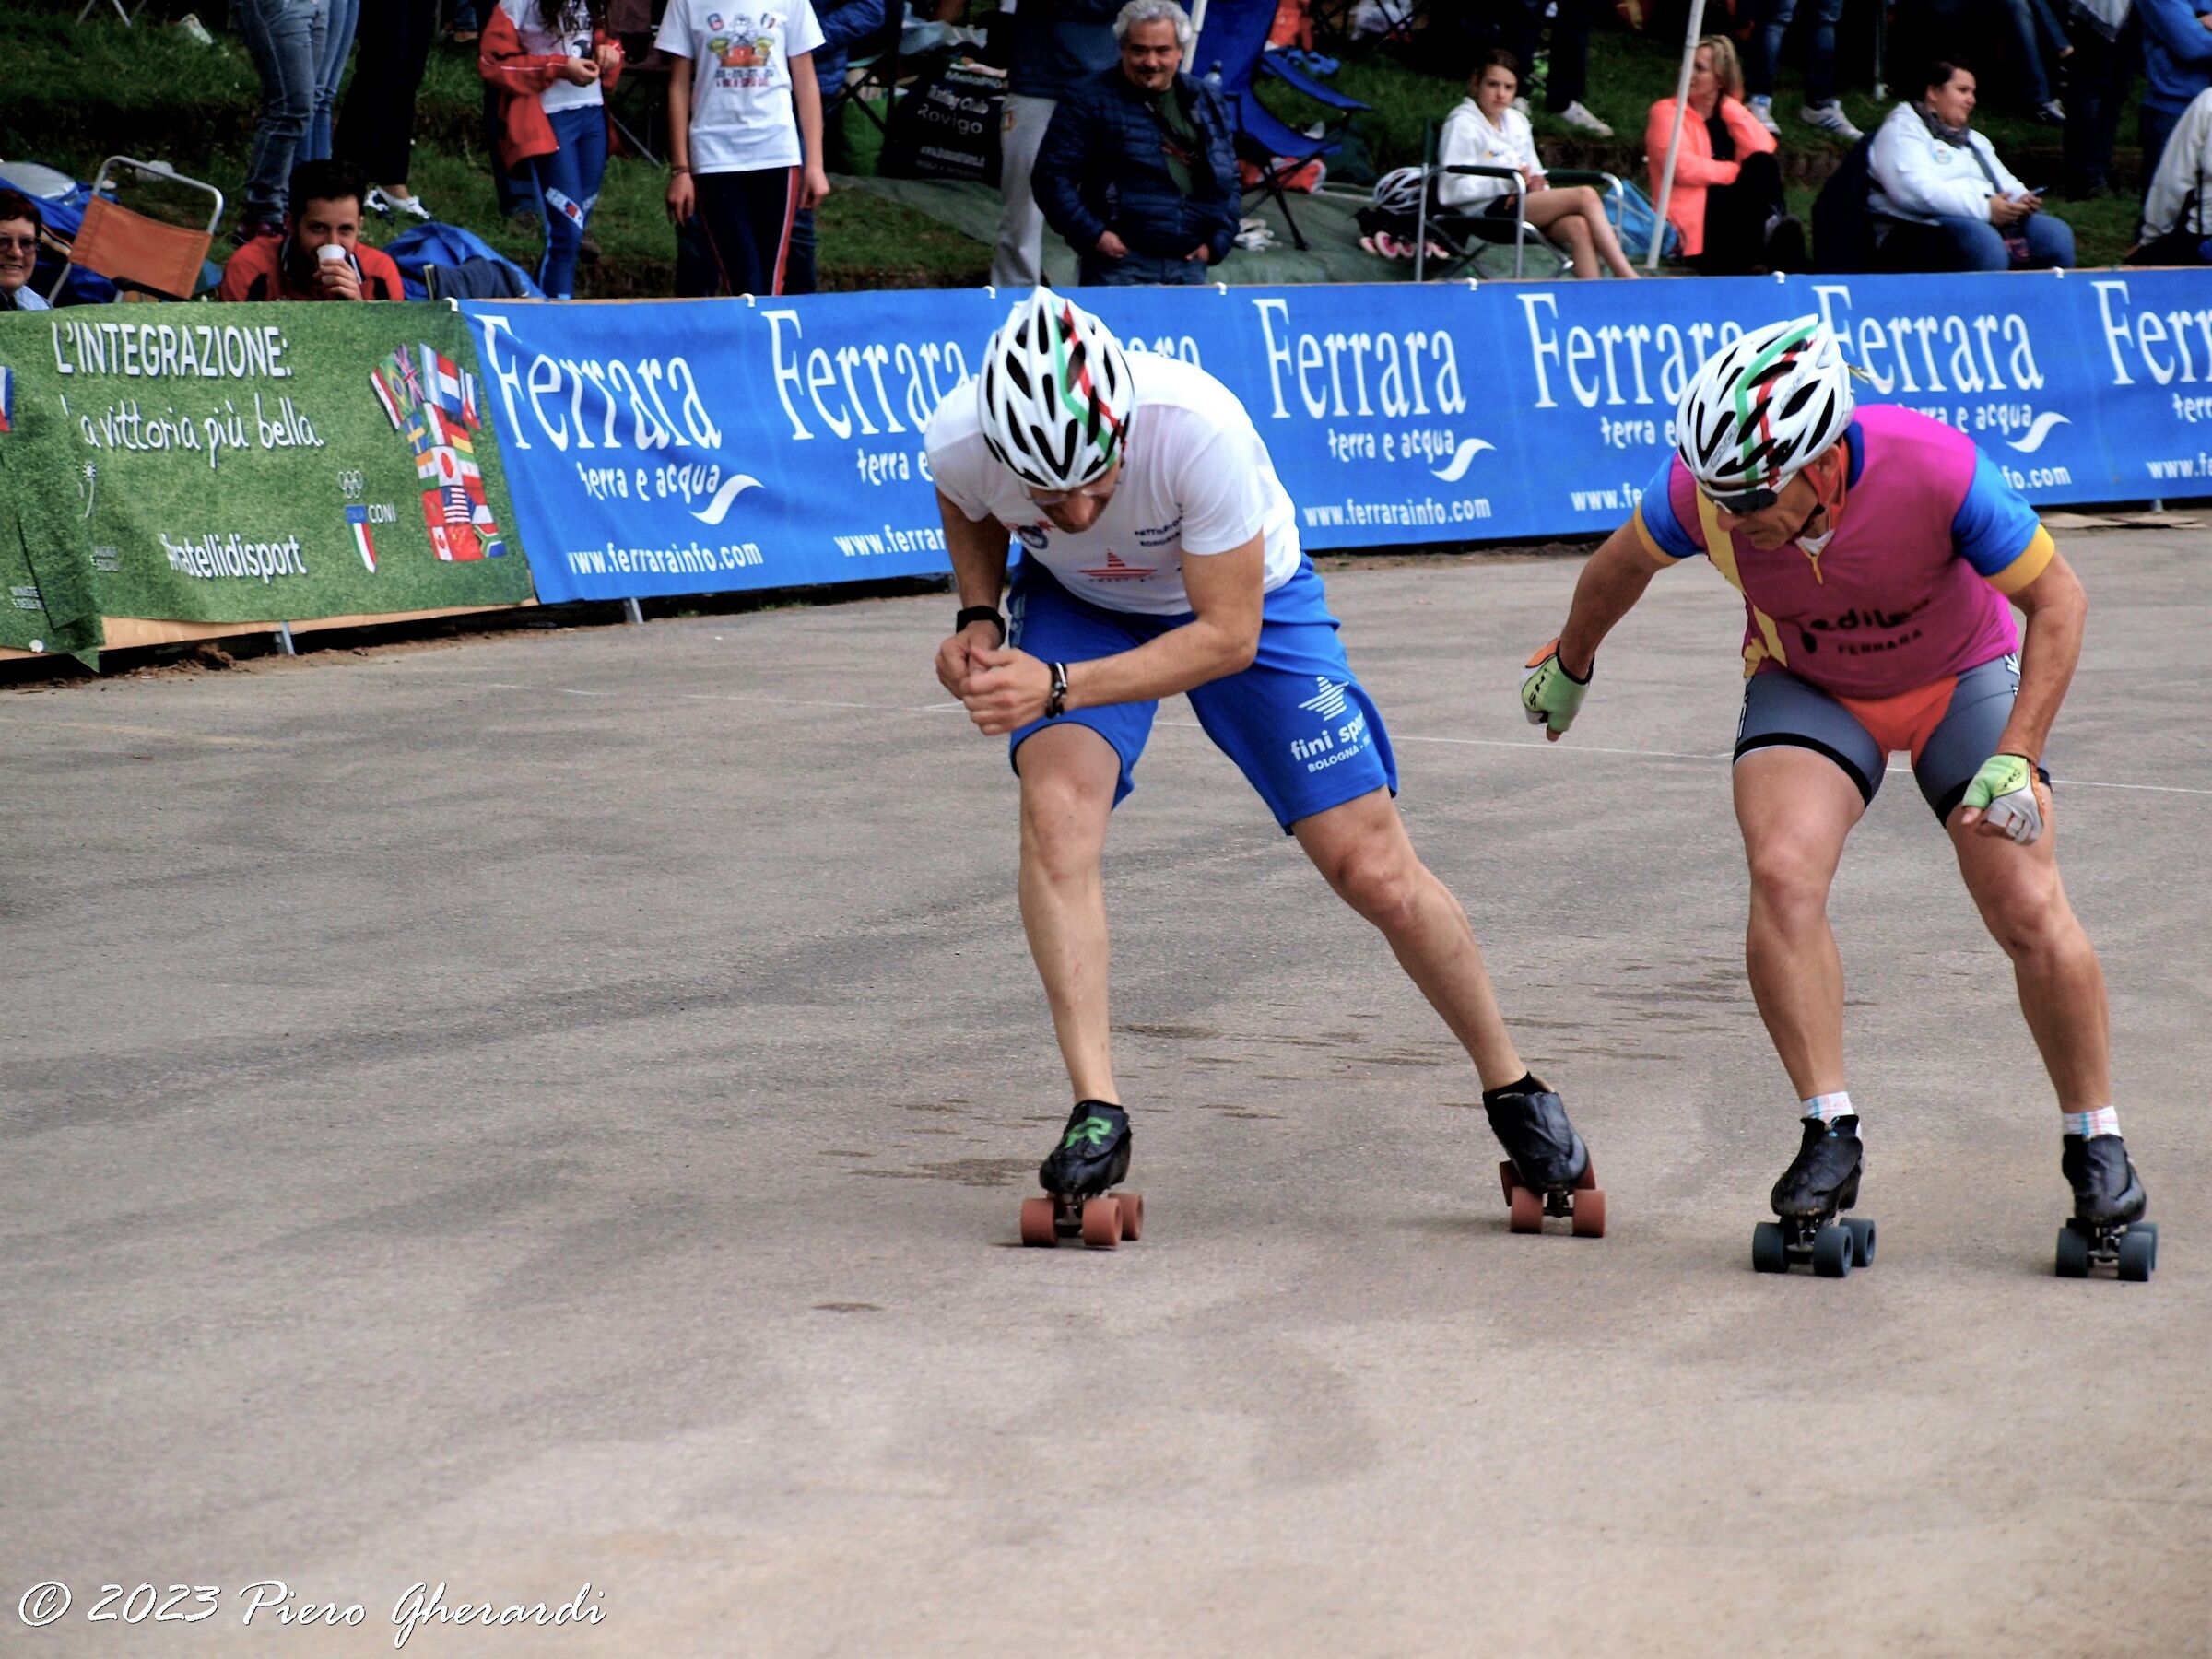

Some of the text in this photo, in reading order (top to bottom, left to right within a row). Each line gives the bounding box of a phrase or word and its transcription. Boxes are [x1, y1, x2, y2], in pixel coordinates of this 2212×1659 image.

[916, 103, 984, 135] Rovigo
[51, 321, 293, 378] L'INTEGRAZIONE:
[1811, 284, 2044, 395] Ferrara
[1253, 298, 1466, 419] Ferrara
[473, 313, 722, 452] Ferrara
[100, 398, 202, 451] vittoria
[203, 399, 250, 469] più
[253, 392, 324, 450] bella.
[1601, 416, 1677, 449] terra e
[1955, 406, 1970, 435] e
[1975, 403, 2033, 436] acqua
[1327, 428, 1455, 464] terra e acqua
[577, 461, 720, 504] terra e acqua
[857, 448, 934, 486] terra e
[368, 504, 397, 524] CONI
[1304, 498, 1492, 527] www.ferrarainfo.com
[1290, 729, 1335, 761] fini
[1307, 744, 1360, 773] BOLOGNA
